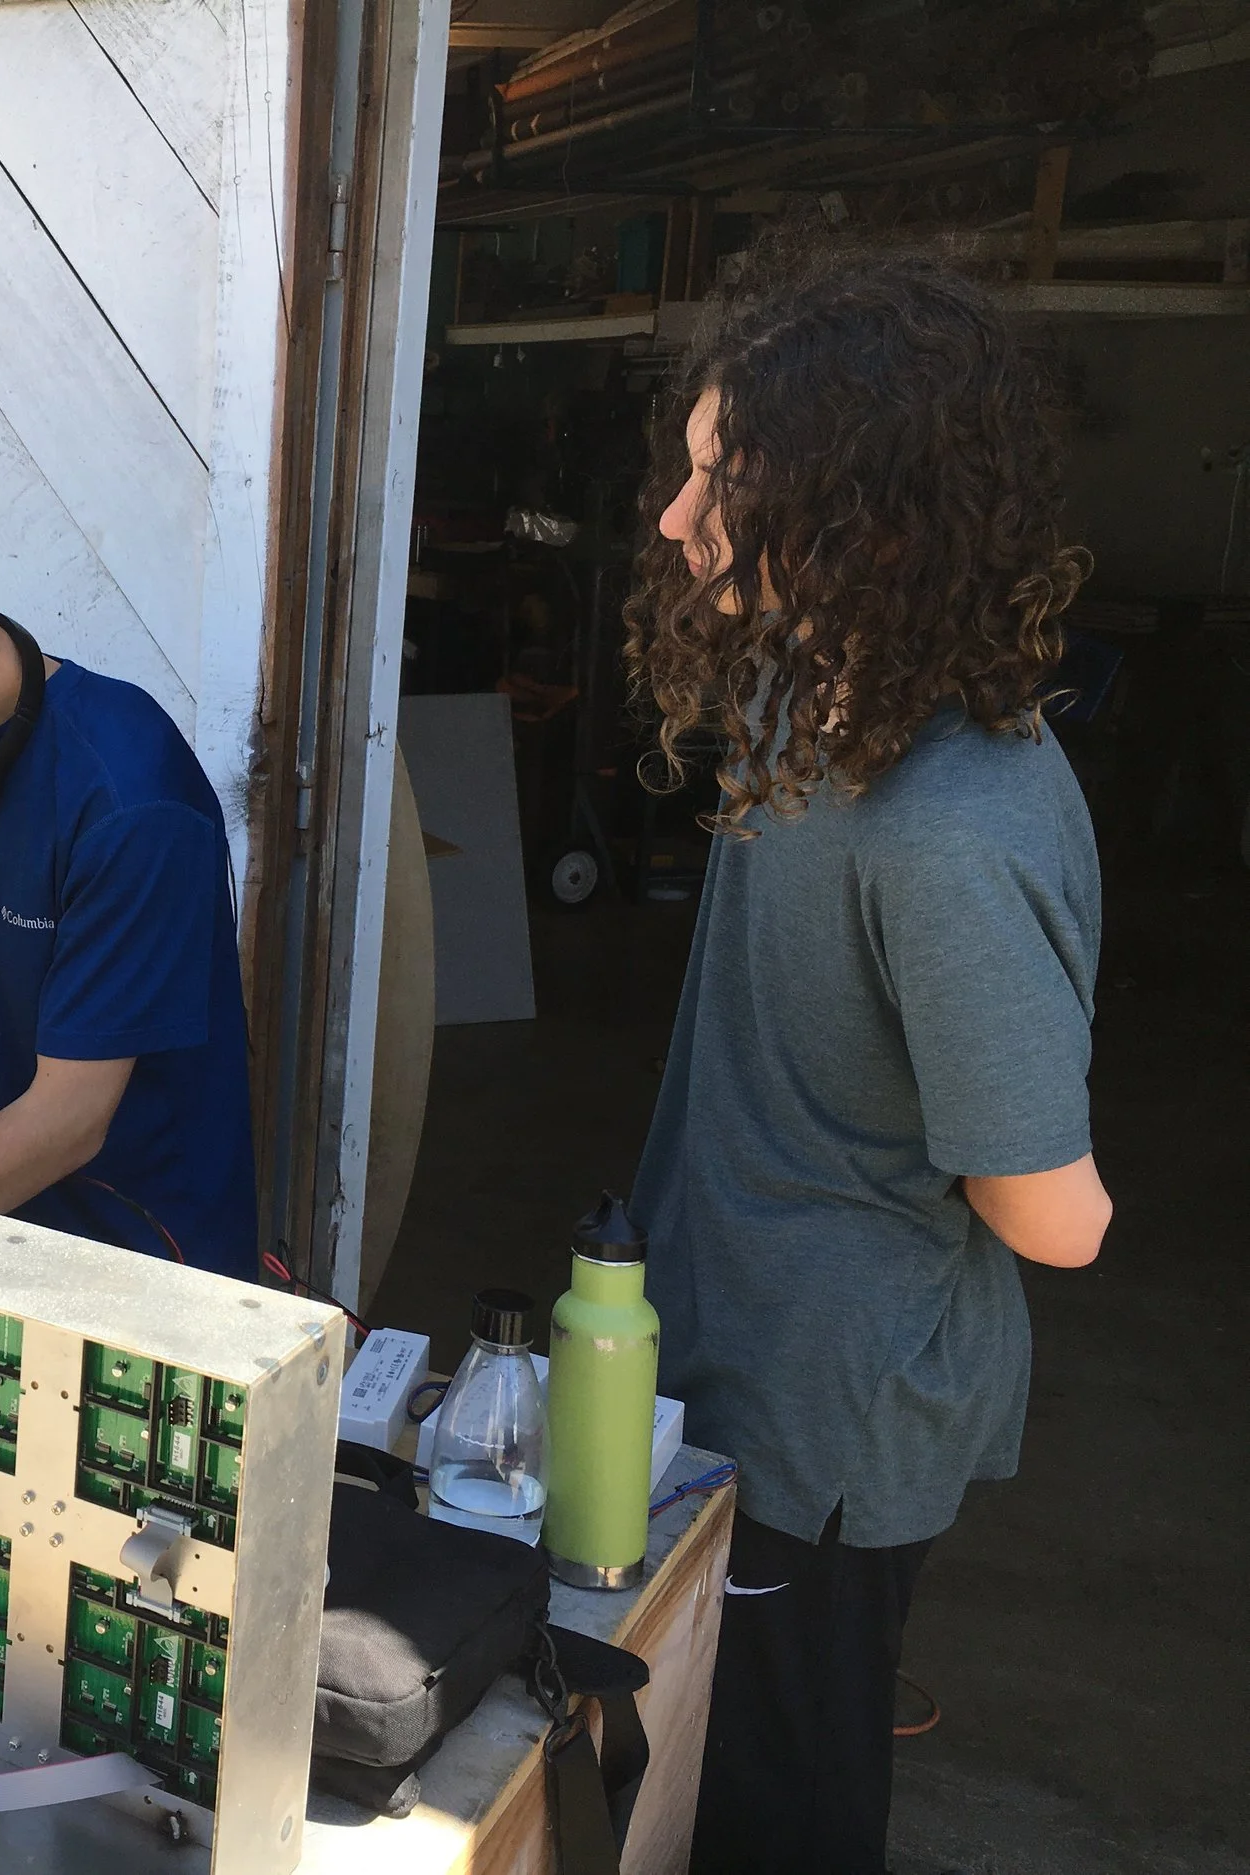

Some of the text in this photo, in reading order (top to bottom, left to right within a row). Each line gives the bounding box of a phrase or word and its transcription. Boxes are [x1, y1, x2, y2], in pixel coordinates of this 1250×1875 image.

[6, 910, 55, 930] Columbia
[173, 1434, 181, 1462] H1644
[157, 1694, 165, 1721] H1644
